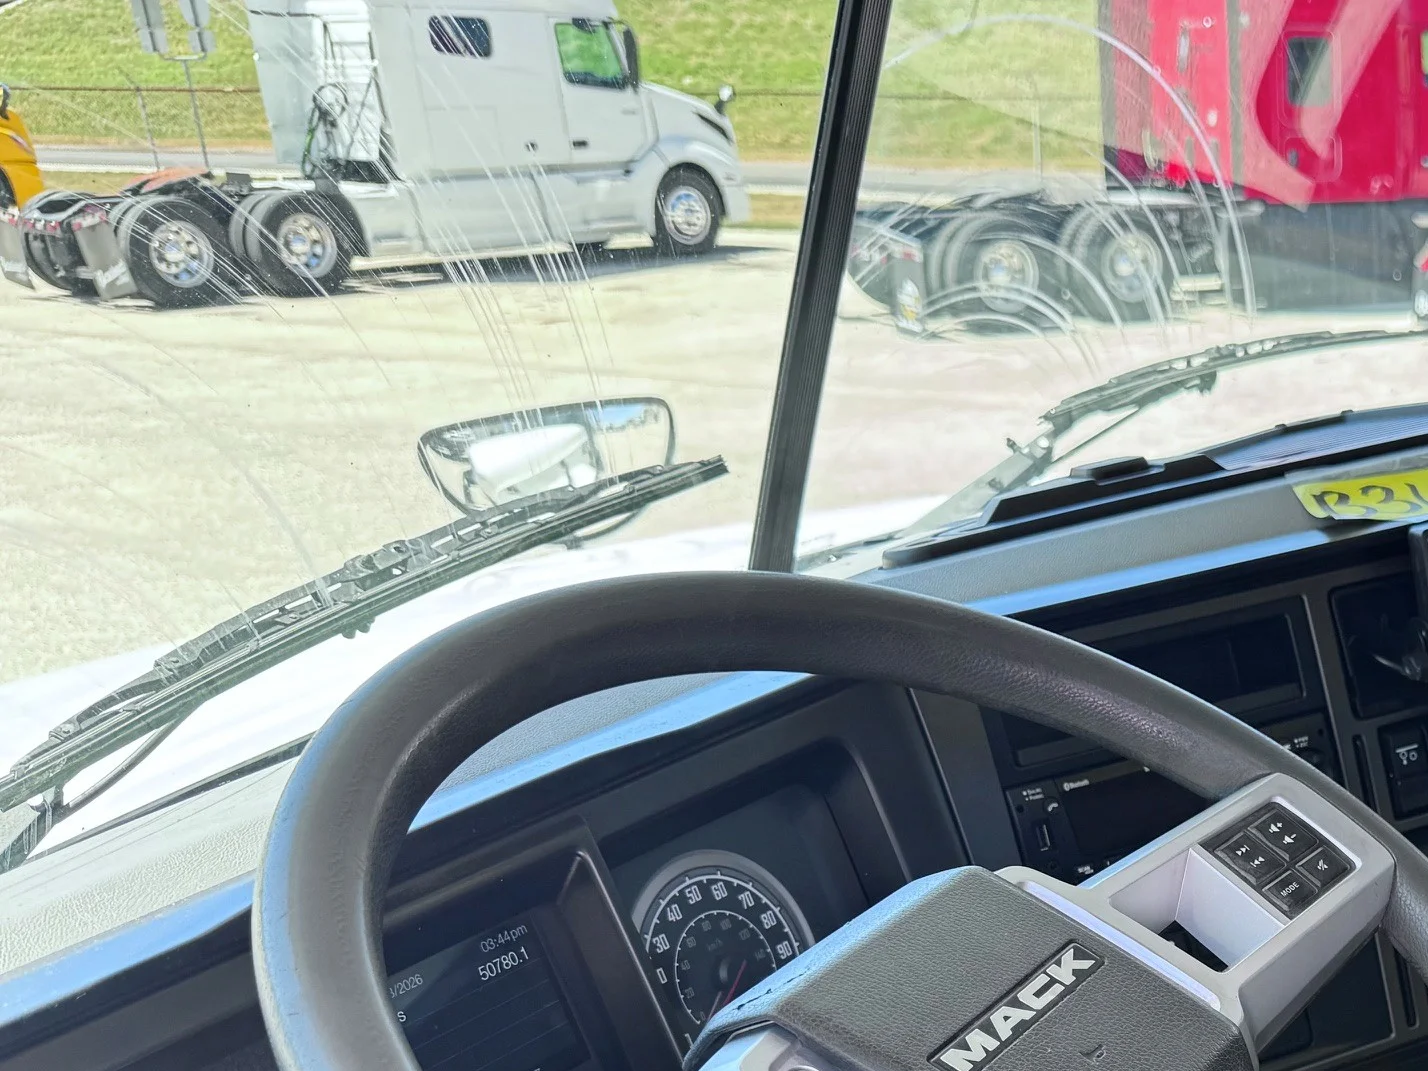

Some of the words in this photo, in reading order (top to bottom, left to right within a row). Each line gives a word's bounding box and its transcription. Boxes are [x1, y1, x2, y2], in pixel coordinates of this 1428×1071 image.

[685, 885, 702, 904] 50
[711, 881, 728, 901] 60
[1280, 881, 1300, 898] MODE
[738, 891, 755, 910] 70
[666, 904, 683, 922] 40
[760, 910, 777, 929] 80
[480, 923, 529, 953] 03:44pm
[653, 933, 670, 953] 30
[775, 941, 792, 960] 90
[478, 946, 530, 981] 50780.1
